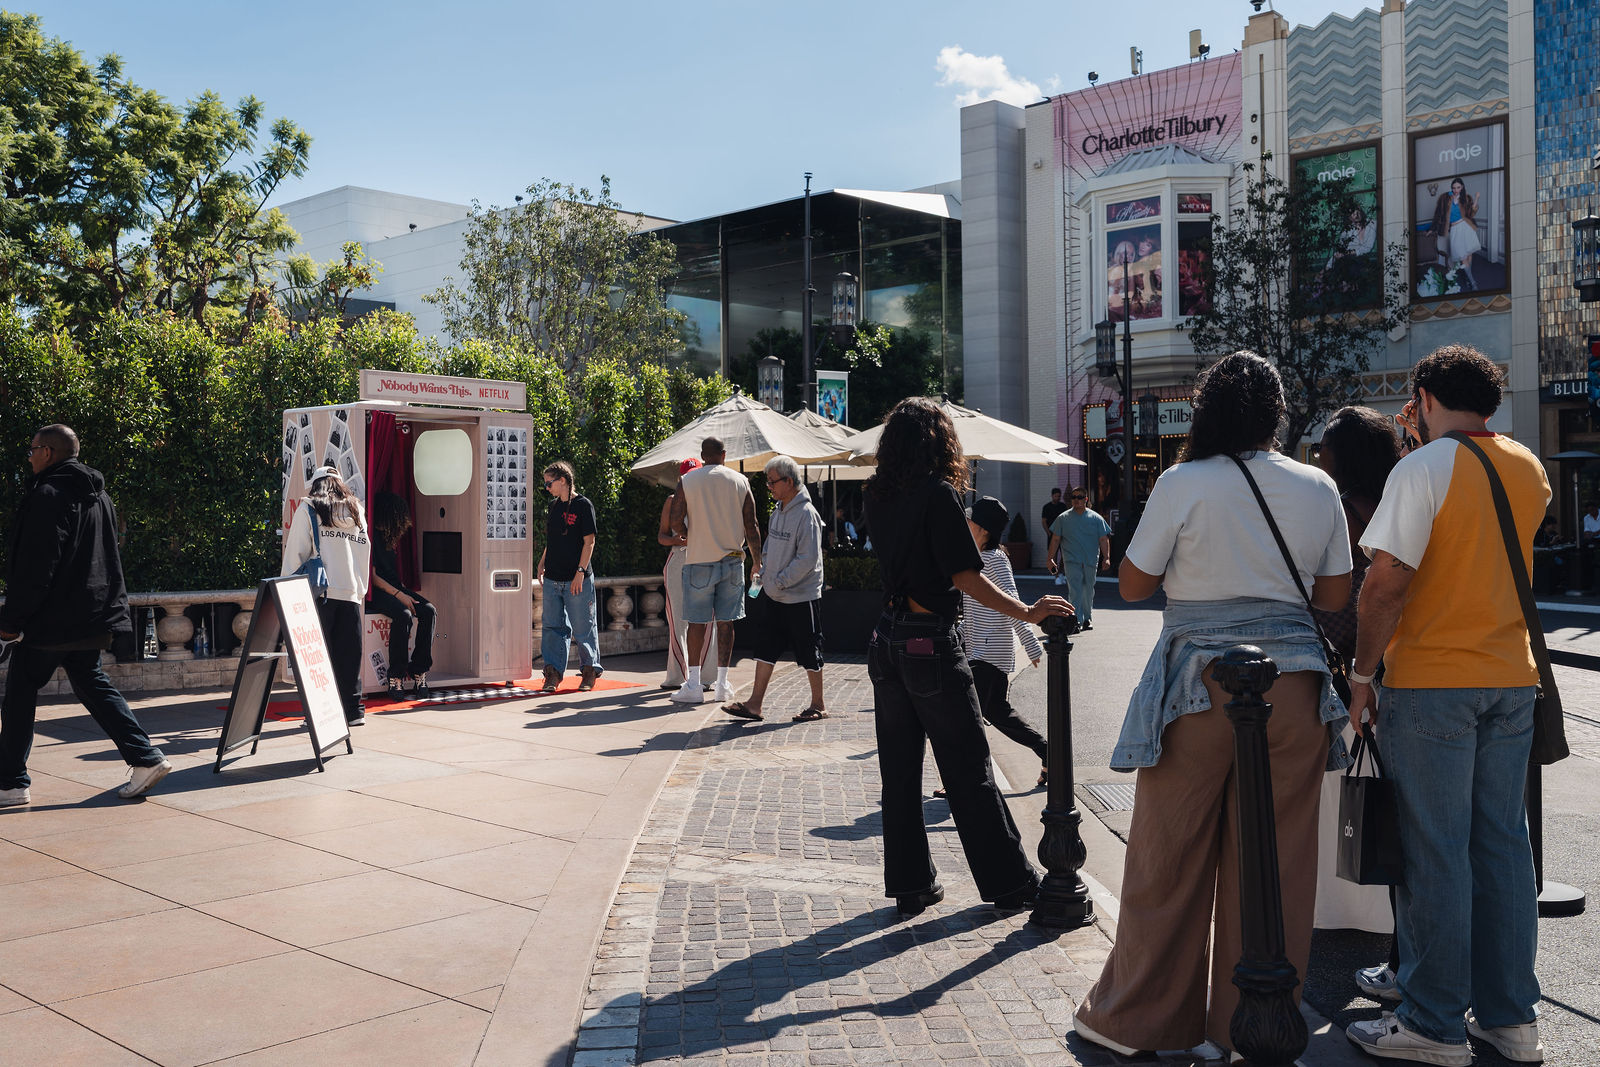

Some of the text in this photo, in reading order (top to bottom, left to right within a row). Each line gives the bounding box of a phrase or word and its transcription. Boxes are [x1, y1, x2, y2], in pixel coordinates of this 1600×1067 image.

[1439, 143, 1482, 163] maje
[377, 379, 510, 400] Nobody Wants This. NETFLIX
[321, 530, 367, 545] LOS ANGELES
[292, 624, 323, 655] Nobody
[300, 646, 325, 668] Wants
